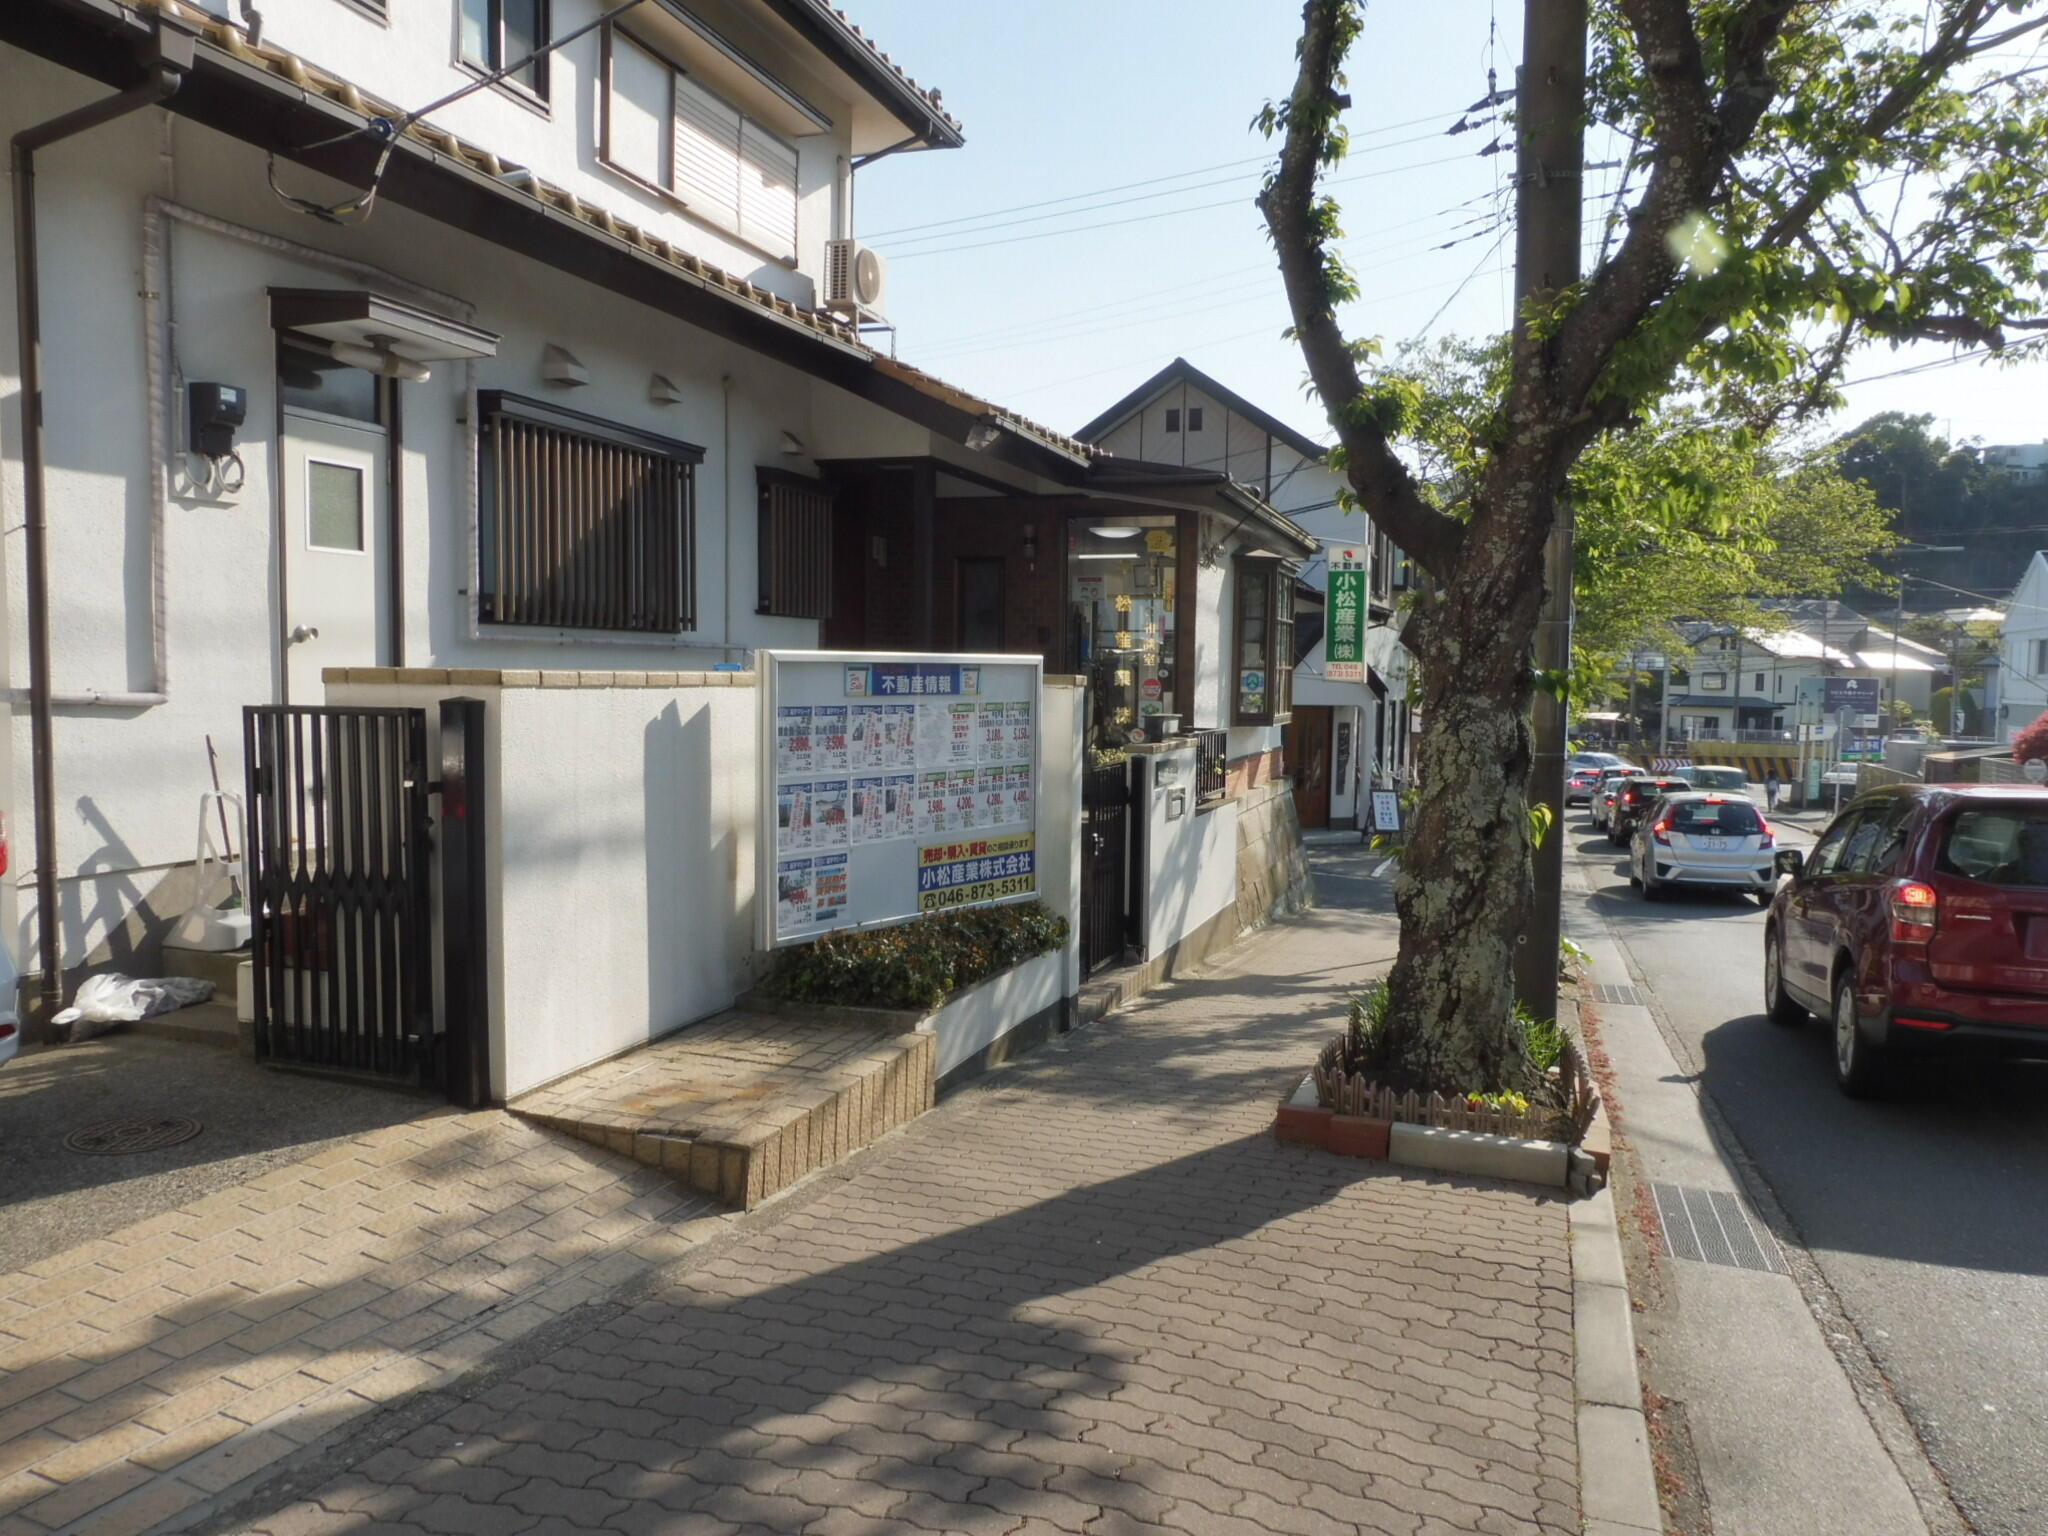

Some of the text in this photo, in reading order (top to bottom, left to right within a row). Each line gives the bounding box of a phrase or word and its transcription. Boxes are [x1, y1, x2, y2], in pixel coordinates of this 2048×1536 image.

[1331, 562, 1363, 570] 不動産
[882, 675, 951, 694] 不動産情報
[922, 852, 1031, 889] 小松産業株式会社
[938, 876, 1030, 905] 046-873-5311
